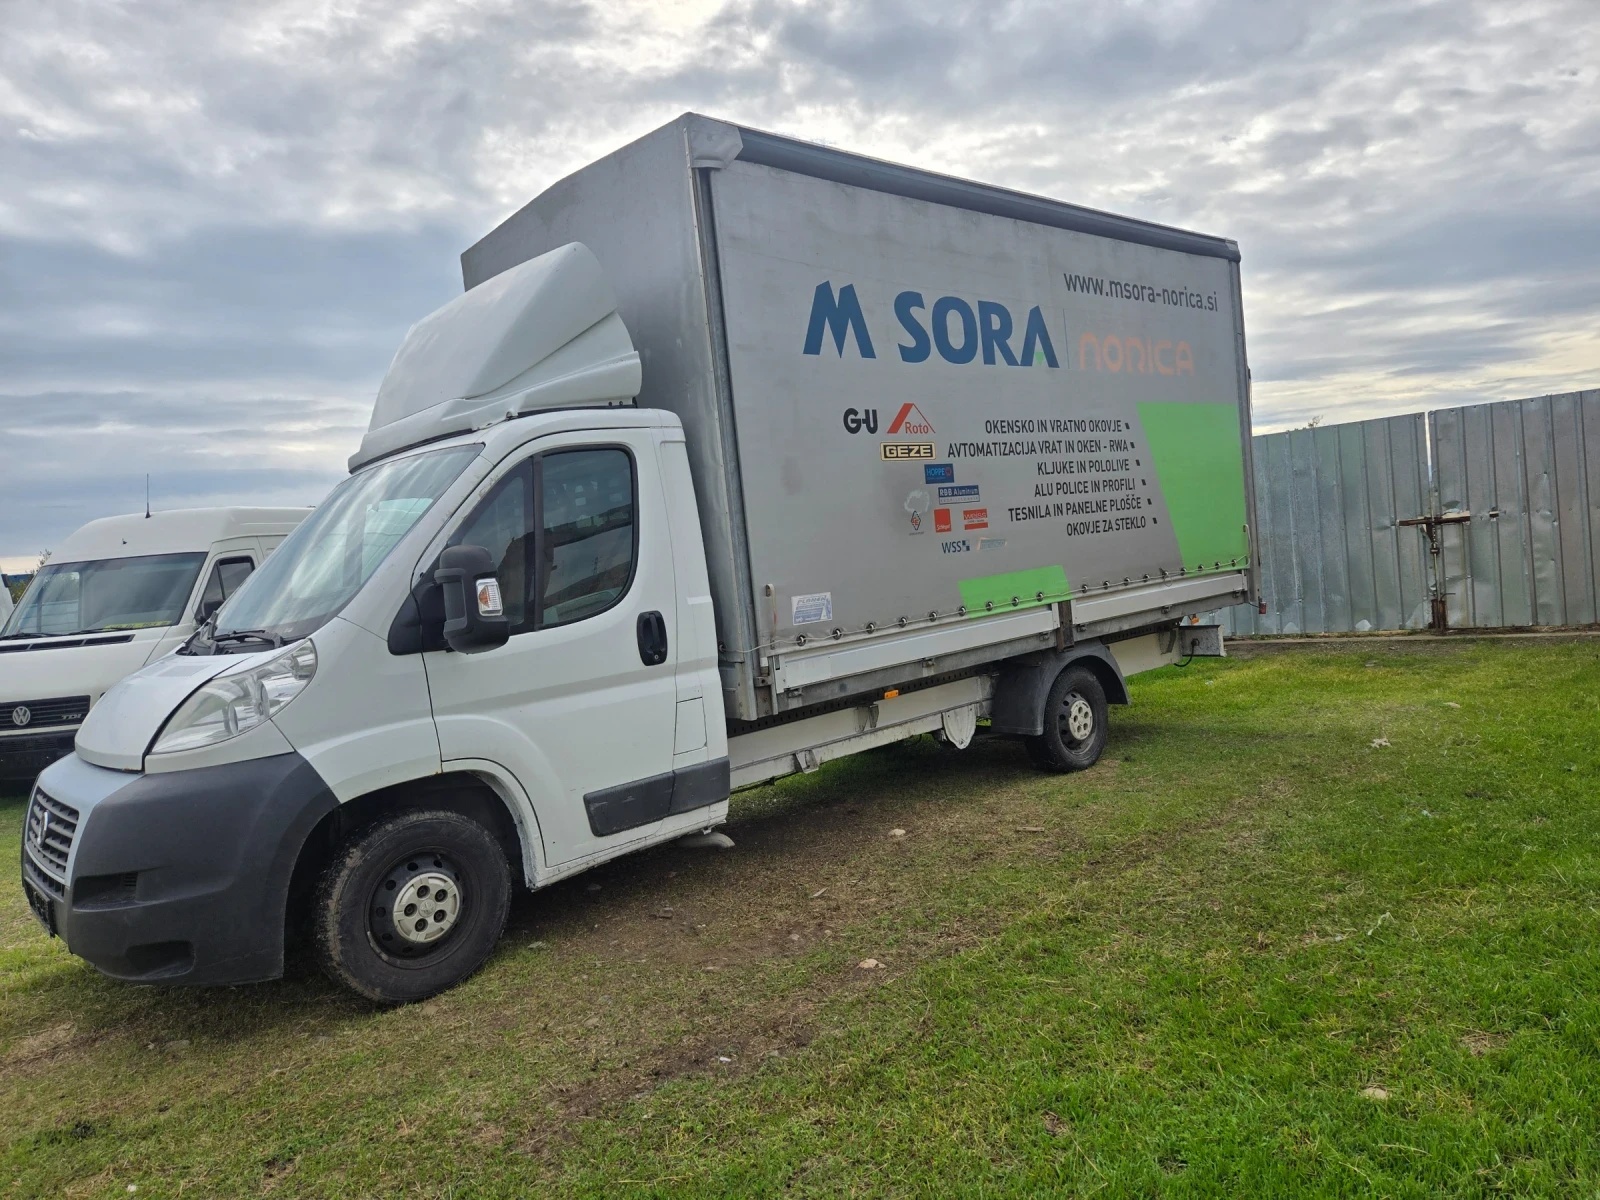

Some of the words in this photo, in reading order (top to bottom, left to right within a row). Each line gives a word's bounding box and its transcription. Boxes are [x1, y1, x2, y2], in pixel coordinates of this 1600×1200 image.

[1063, 273, 1218, 312] www.msora-norica.si
[802, 280, 877, 359] M
[894, 290, 1060, 368] SORA
[904, 421, 929, 434] Roto
[985, 420, 1035, 434] OKENSKO
[1037, 420, 1048, 433] IN
[1050, 419, 1087, 433] VRATNO
[1088, 419, 1122, 432] OKOVJE
[885, 445, 931, 458] GEZE
[947, 441, 1037, 458] AVTOMATIZACIJA
[1037, 440, 1063, 454] VRAT
[1065, 440, 1075, 453] IN
[1076, 439, 1101, 453] OKEN
[1109, 439, 1129, 452] RWA
[1037, 461, 1074, 475] KLJUKE
[1076, 461, 1087, 474] IN
[1088, 459, 1130, 473] POLOLIVE
[1034, 483, 1053, 497] ALU
[1056, 481, 1089, 495] POLICE
[1091, 480, 1100, 493] IN
[1102, 478, 1136, 492] PROFILI
[1008, 504, 1052, 522] TESNILA
[1053, 503, 1064, 516] IN
[1065, 499, 1108, 516] PANELNE
[1109, 494, 1142, 512] PLOŠČE
[1066, 520, 1101, 536] OKOVJE
[1102, 519, 1114, 533] ZA
[1115, 516, 1147, 531] STEKLO
[941, 540, 962, 554] WSS
